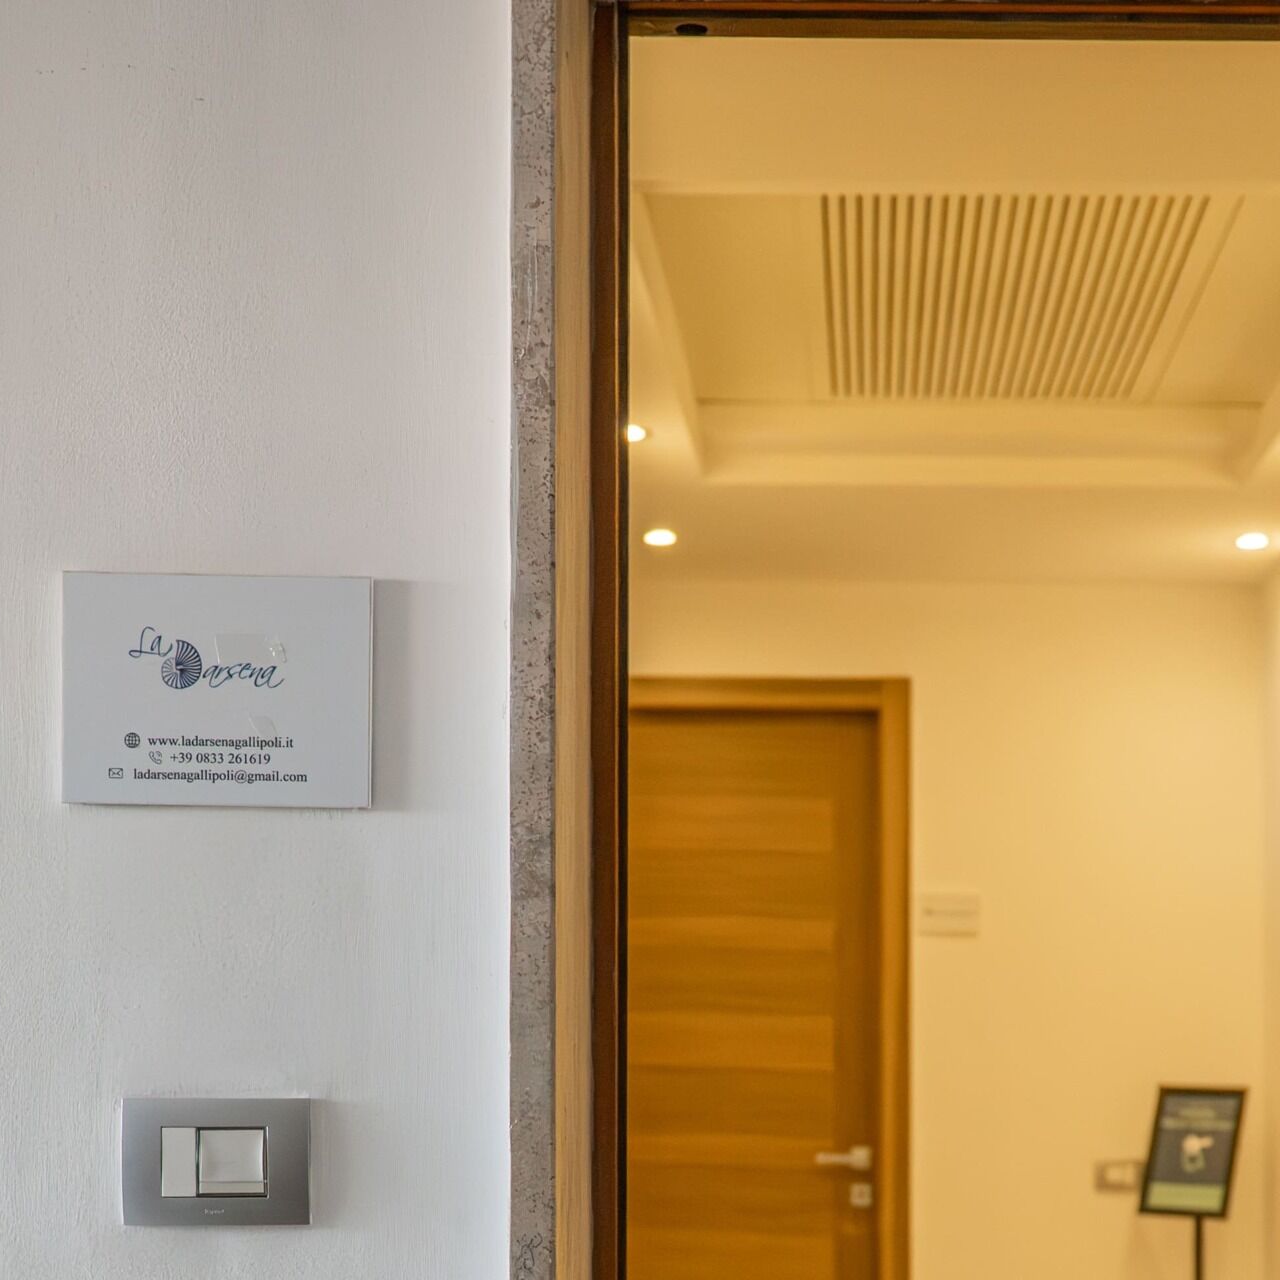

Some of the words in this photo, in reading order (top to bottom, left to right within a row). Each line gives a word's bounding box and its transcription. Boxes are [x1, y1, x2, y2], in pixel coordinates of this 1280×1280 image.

[128, 626, 173, 659] La
[147, 735, 295, 750] www.ladarsenagallipoli.it
[170, 752, 193, 764] +39
[195, 752, 224, 764] 0833
[228, 753, 271, 765] 261619
[133, 768, 308, 784] ladarsenagallipoli@gmail.com
